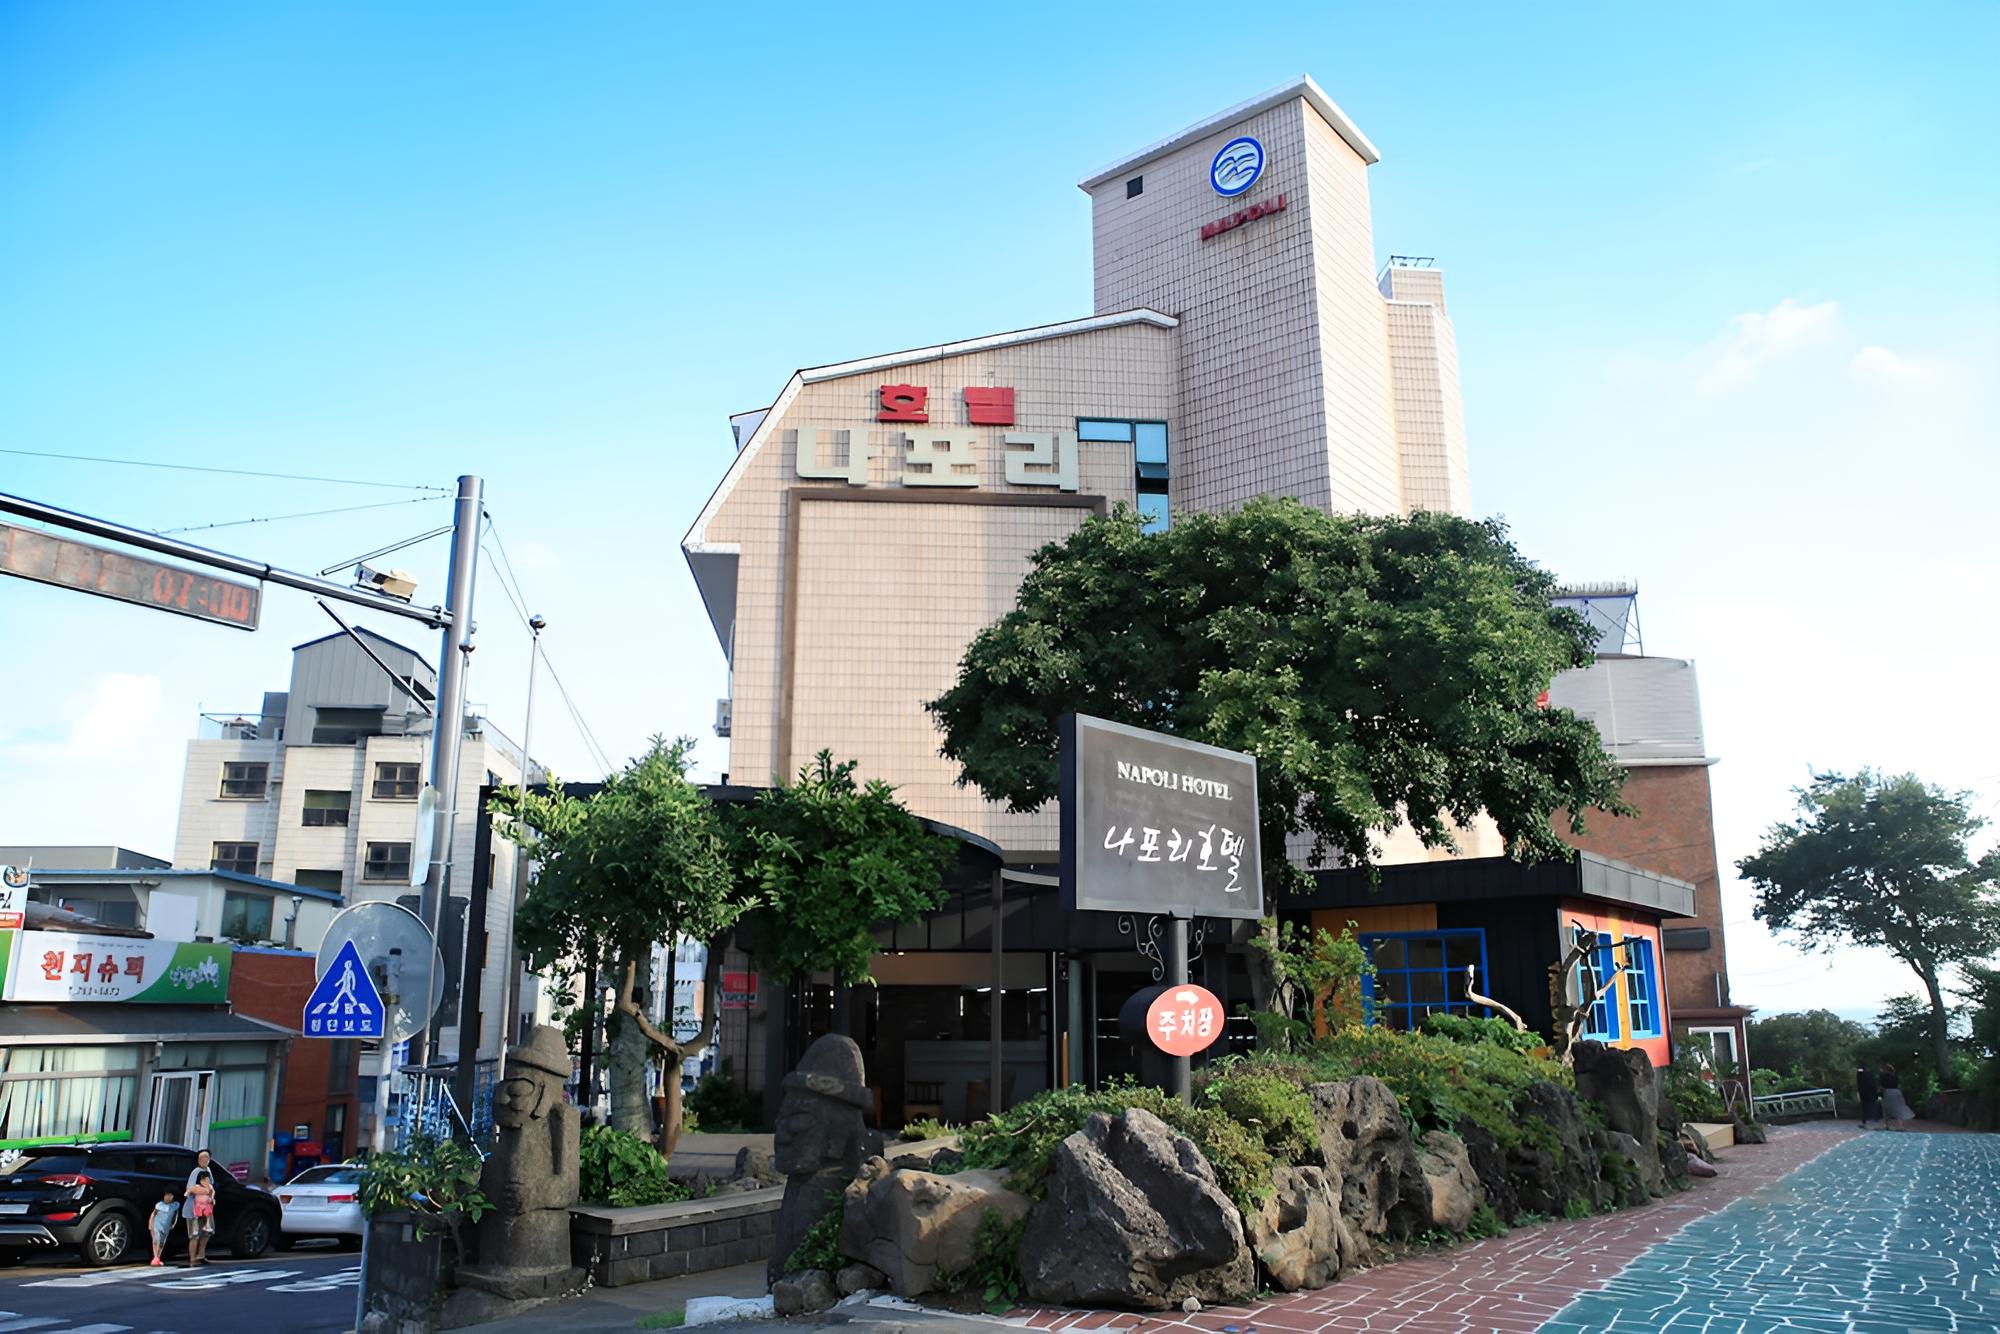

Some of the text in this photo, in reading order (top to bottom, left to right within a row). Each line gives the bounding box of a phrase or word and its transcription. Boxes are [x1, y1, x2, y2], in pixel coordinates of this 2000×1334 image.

[796, 426, 1080, 493] 나포리
[1117, 760, 1233, 800] NAPOLI HOTEL
